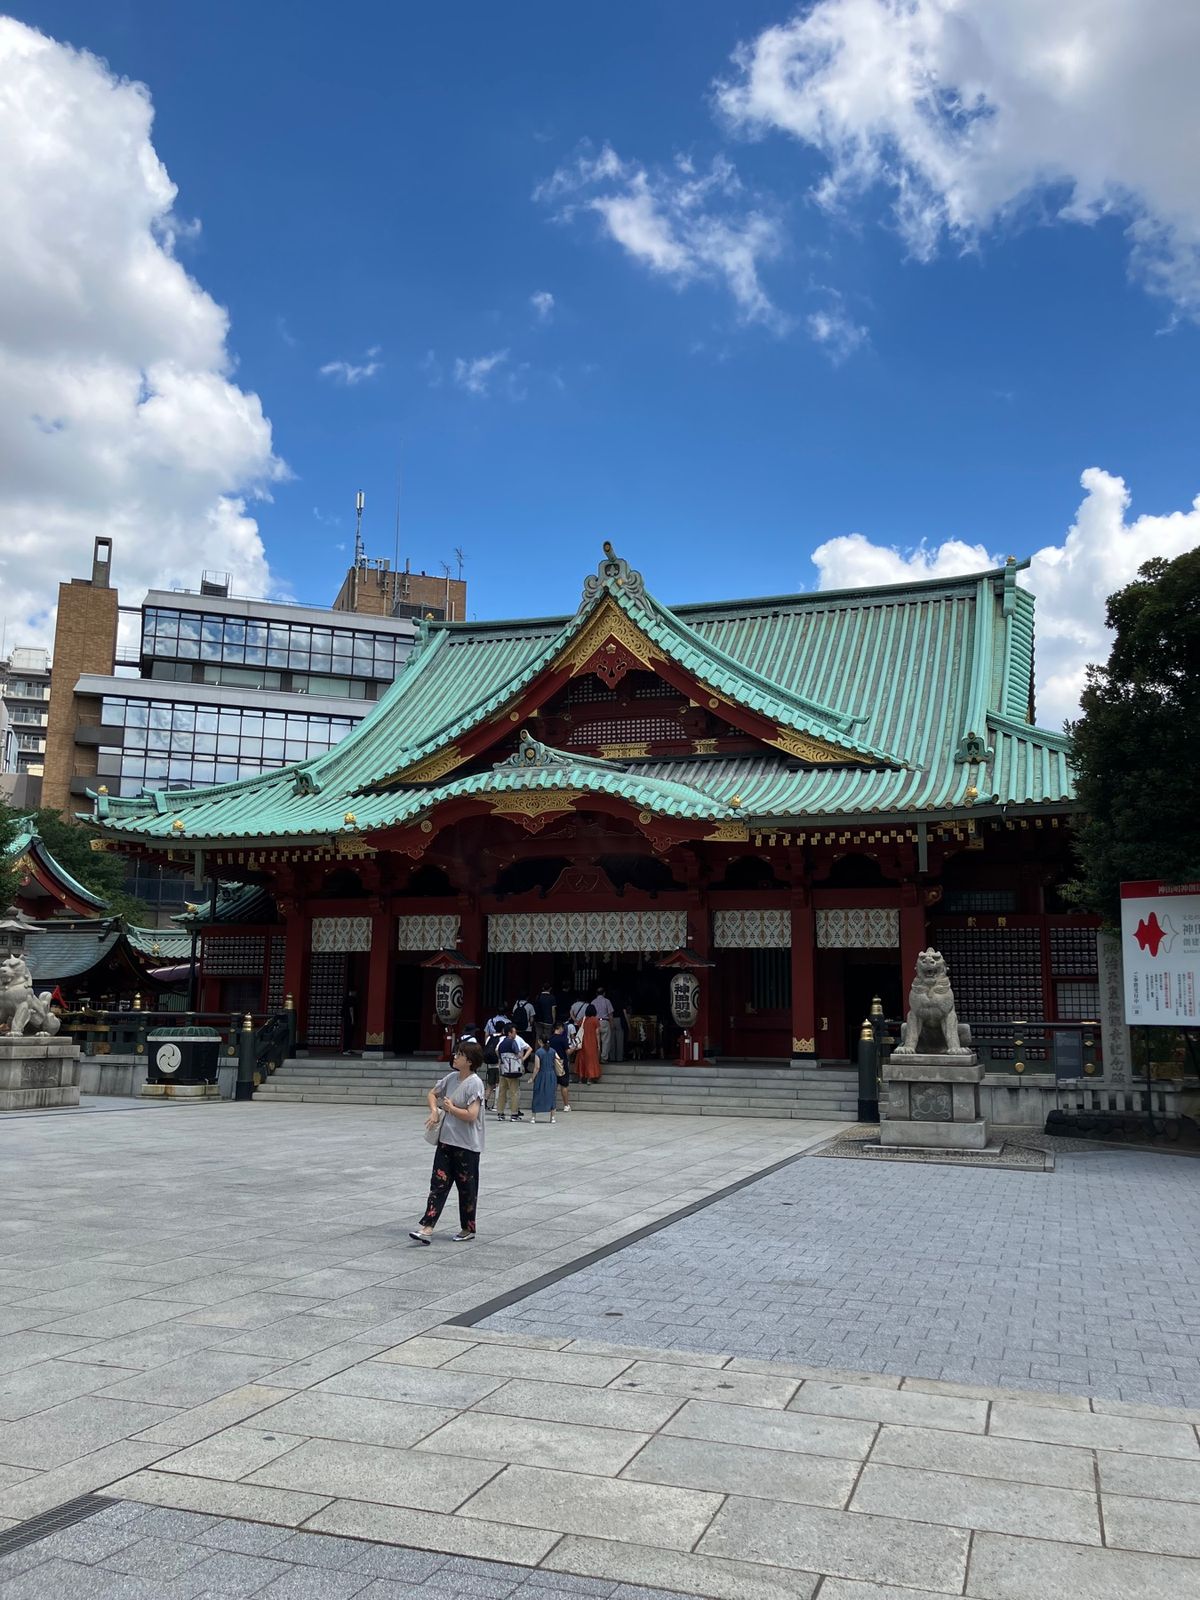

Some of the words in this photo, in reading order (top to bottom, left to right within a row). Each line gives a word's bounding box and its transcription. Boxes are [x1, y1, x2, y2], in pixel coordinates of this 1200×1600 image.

[437, 984, 450, 1016] 神田明神
[674, 984, 691, 1019] 神田明神
